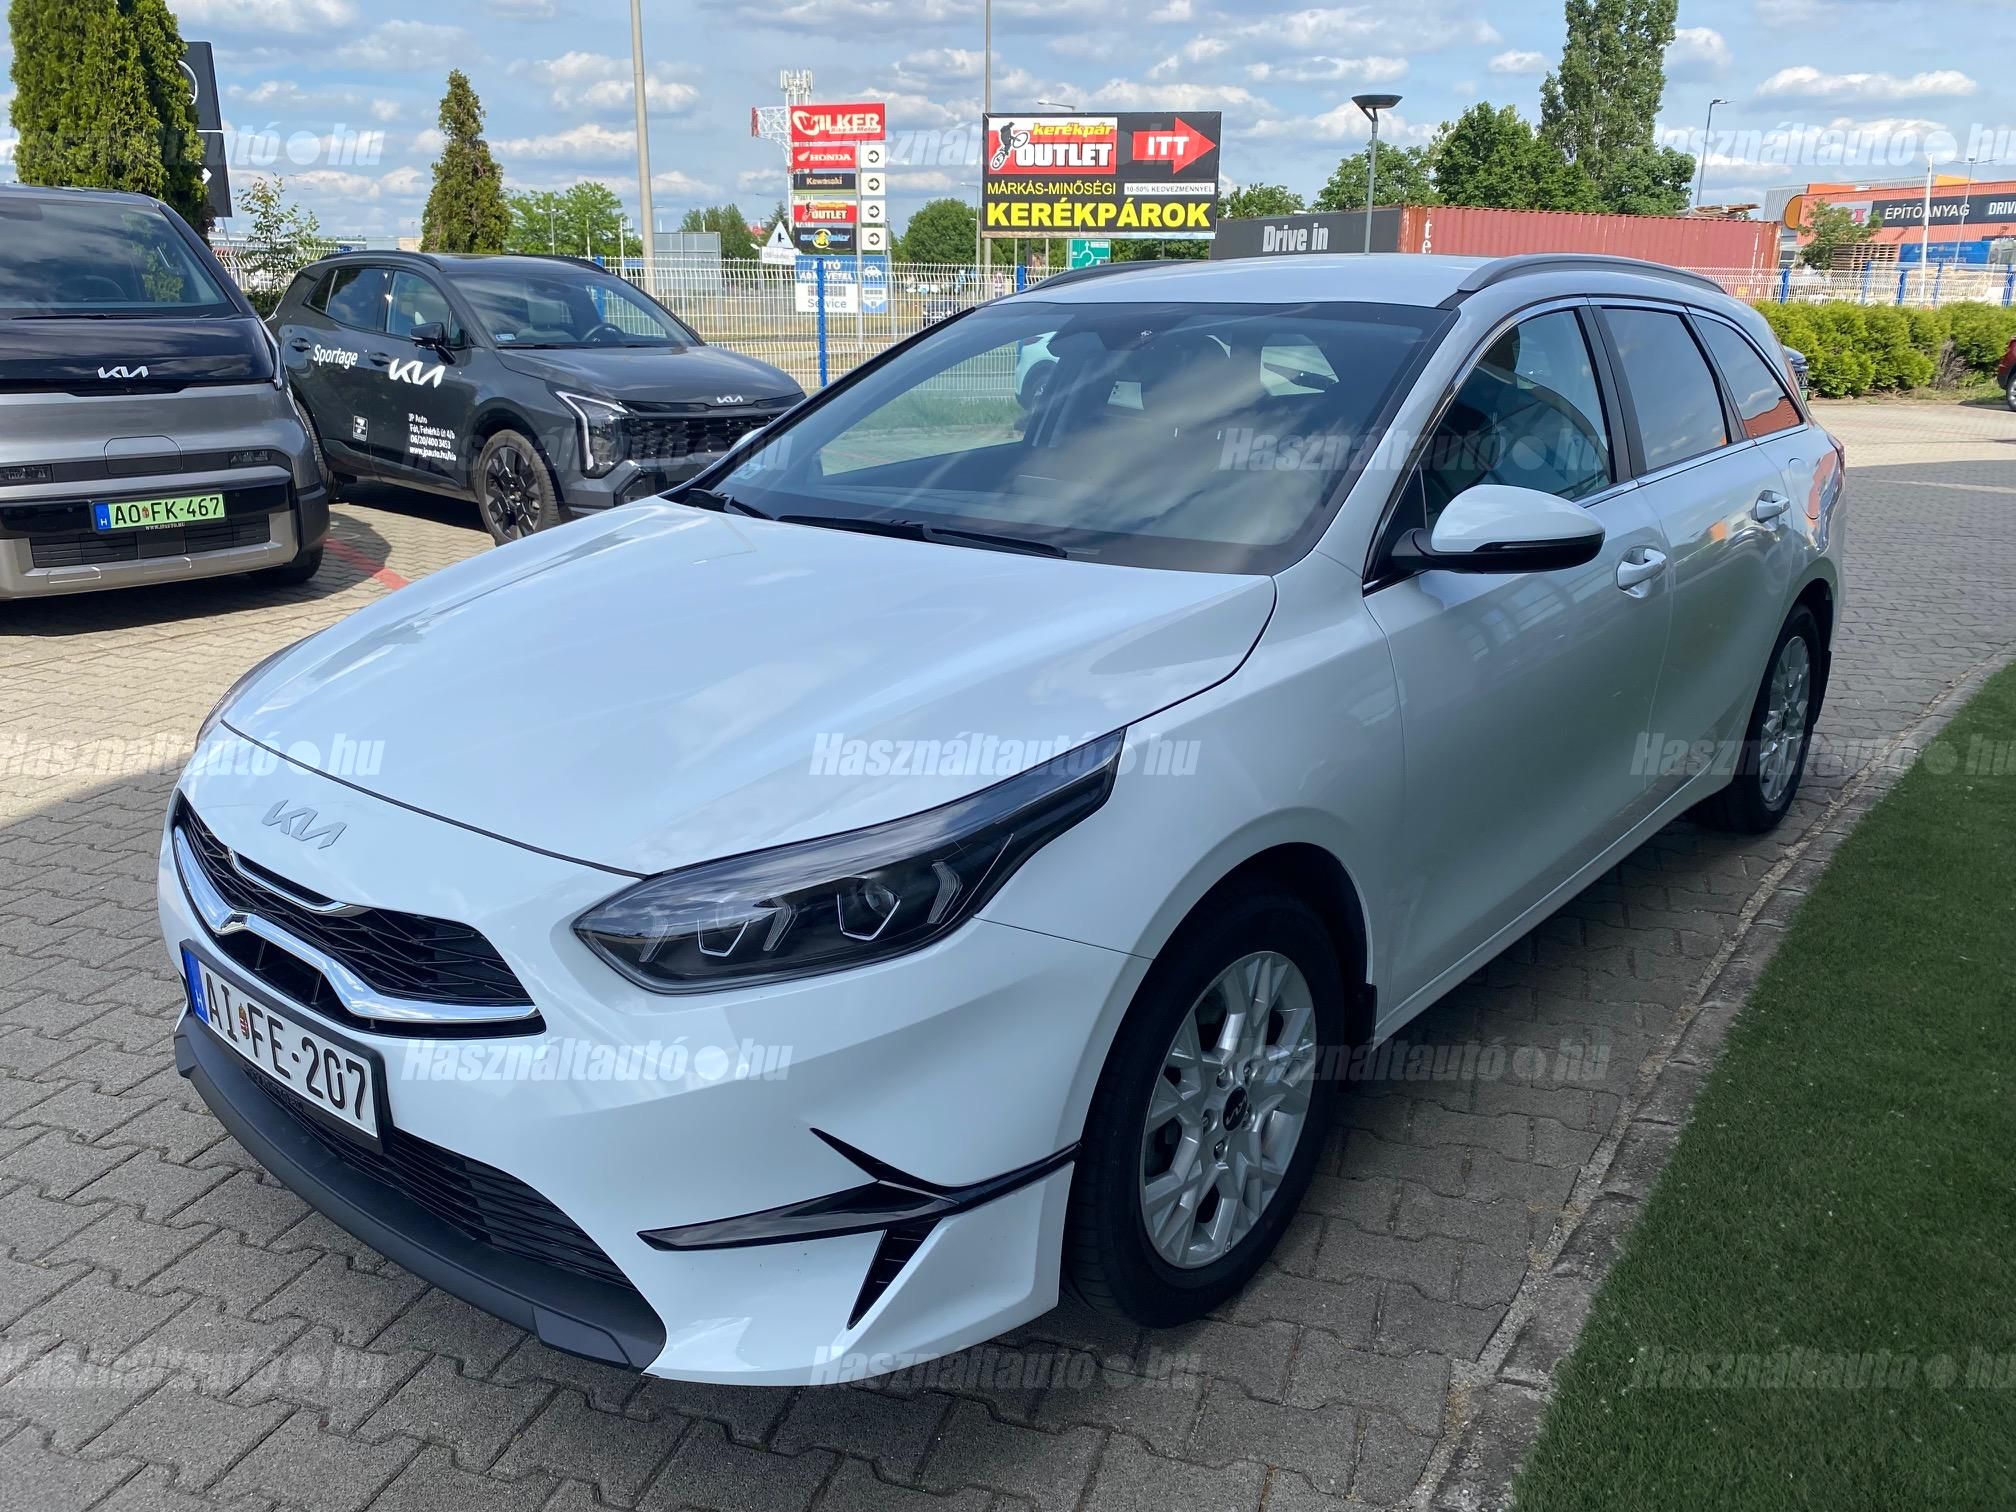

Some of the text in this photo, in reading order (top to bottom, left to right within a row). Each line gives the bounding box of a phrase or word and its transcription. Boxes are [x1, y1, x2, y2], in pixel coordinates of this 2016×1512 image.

[1033, 122, 1115, 138] kerékpár
[1147, 135, 1190, 156] ITT
[810, 153, 852, 161] HONDA
[1015, 142, 1113, 168] OUTLET
[806, 176, 843, 185] Kawasaki
[987, 179, 1116, 195] MÁRKÁS-MINŐSÉGI
[811, 210, 847, 219] OUTLET
[987, 197, 1211, 228] KERÉKPÁROK
[1262, 222, 1329, 252] Drive in
[313, 343, 359, 369] Sportage
[97, 365, 149, 379] KIA
[389, 358, 446, 388] KIA
[716, 395, 744, 404] KIA
[261, 800, 347, 850] KIA
